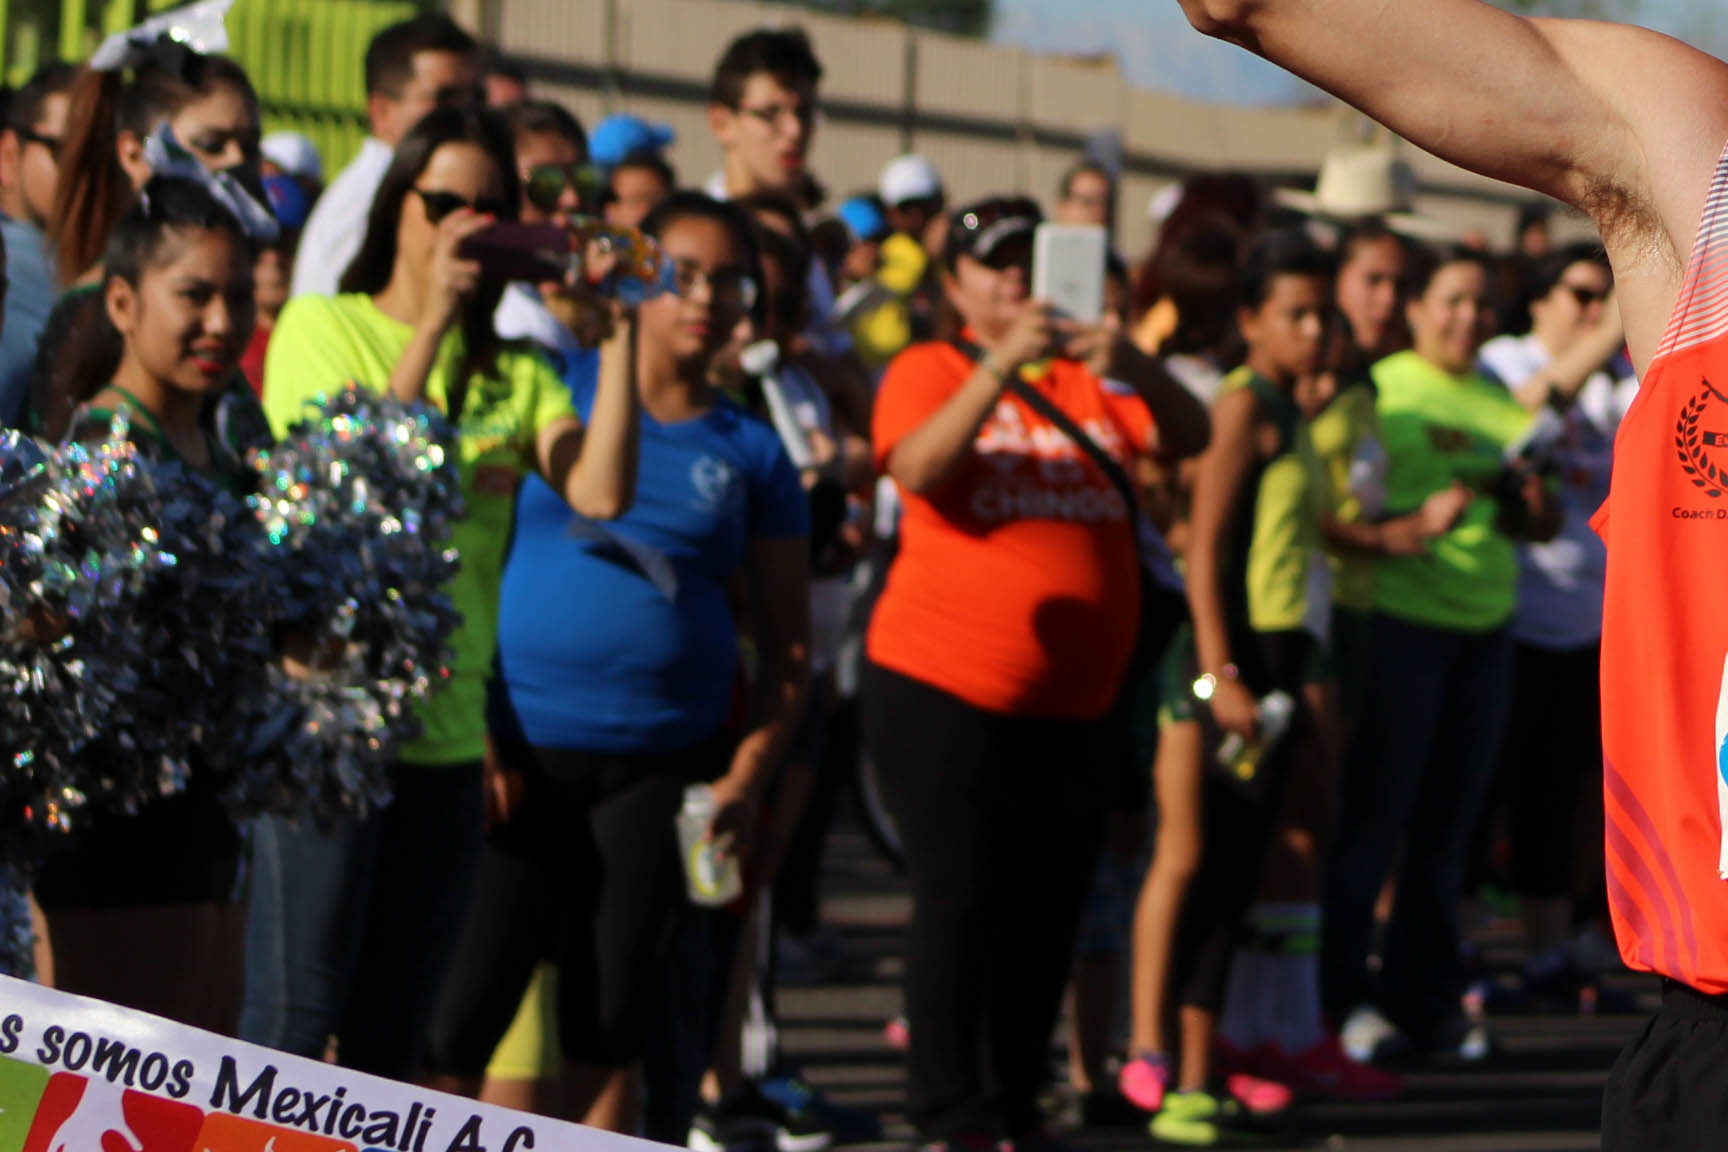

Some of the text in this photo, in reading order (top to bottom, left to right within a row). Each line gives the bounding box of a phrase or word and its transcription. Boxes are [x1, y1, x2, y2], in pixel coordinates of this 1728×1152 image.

[1671, 507, 1714, 520] Coach
[36, 1024, 195, 1098] somos
[209, 1054, 437, 1151] Mexicali
